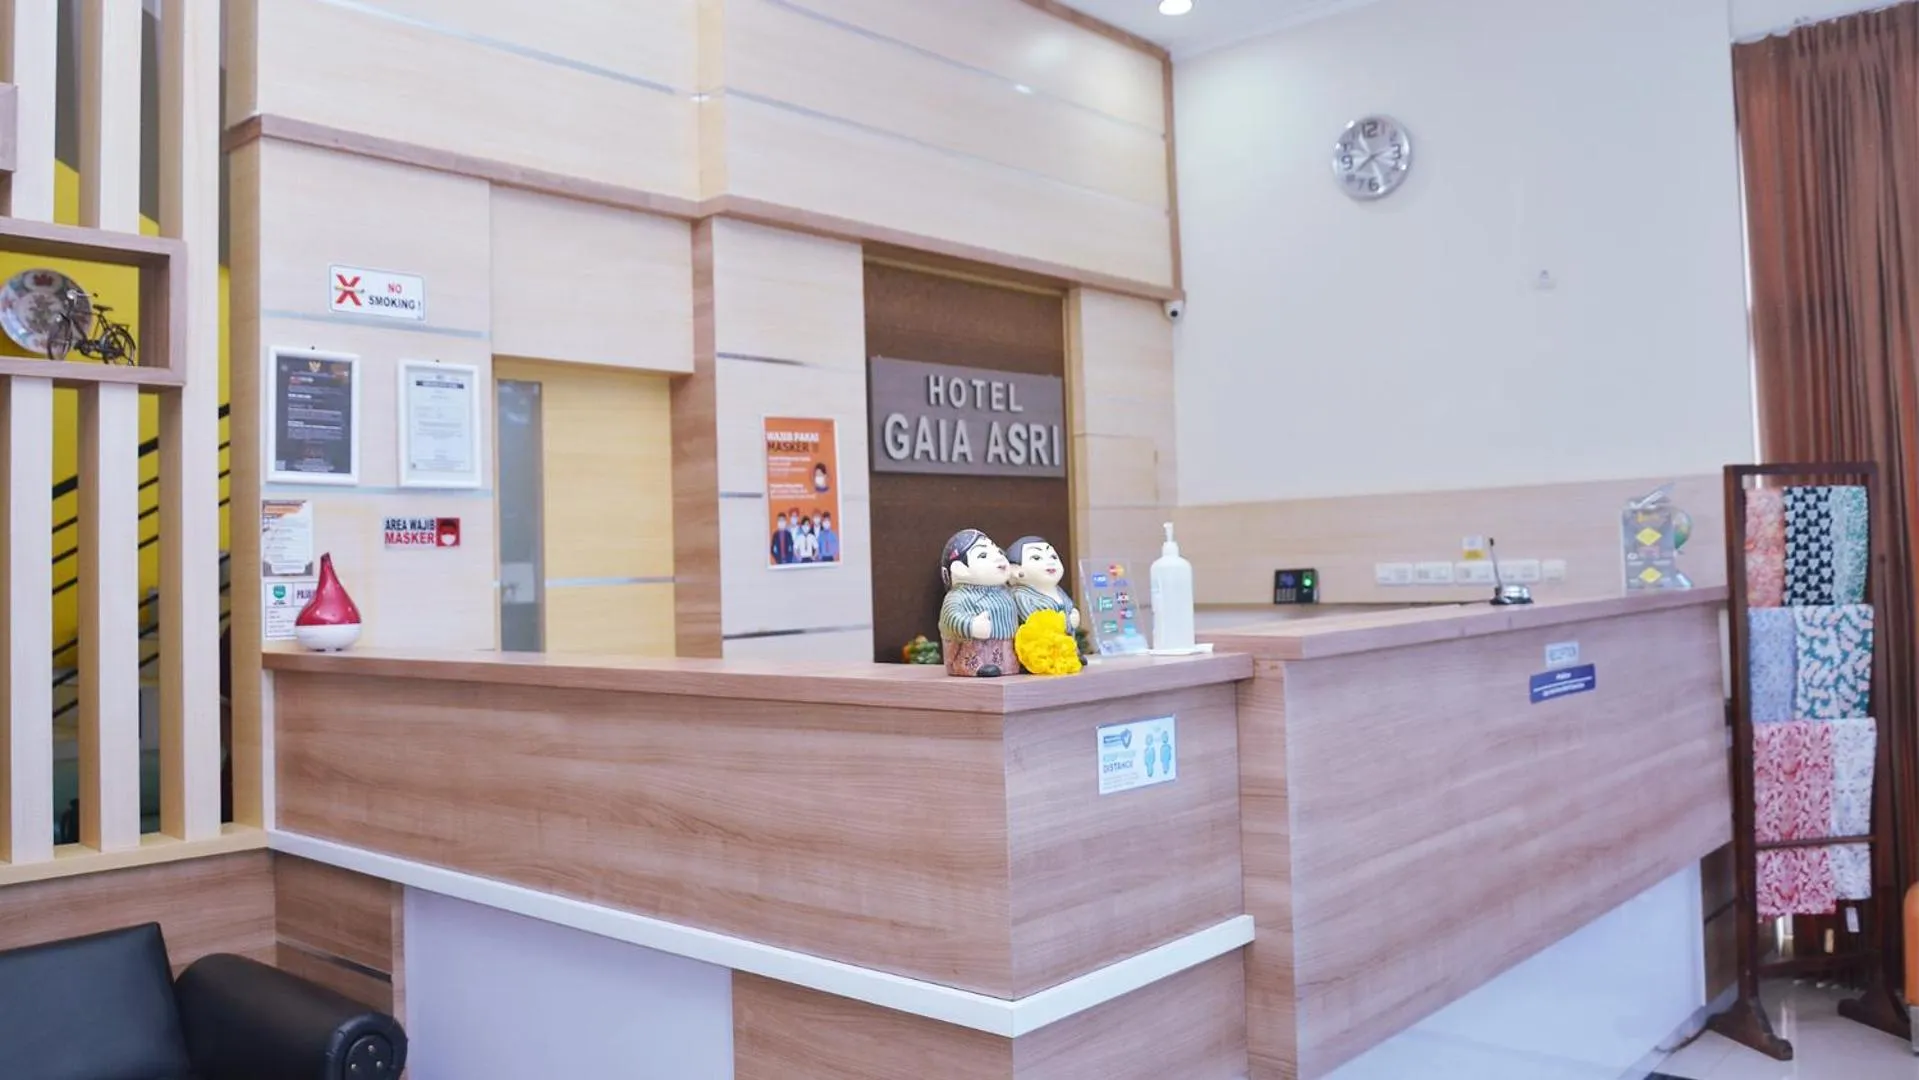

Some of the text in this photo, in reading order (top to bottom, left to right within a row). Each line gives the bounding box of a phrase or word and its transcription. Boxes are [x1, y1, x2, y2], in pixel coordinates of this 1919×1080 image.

[1362, 120, 1378, 138] 12
[1391, 143, 1401, 160] 3
[1341, 155, 1353, 171] 9
[1368, 177, 1380, 192] 6
[388, 283, 402, 294] NO
[368, 295, 415, 310] SMOKING
[927, 373, 1023, 412] HOTEL
[767, 441, 809, 452] MASKER
[884, 412, 1060, 467] GAIA ASRI
[385, 518, 435, 531] AREA WAJIB
[385, 531, 435, 545] MASKER
